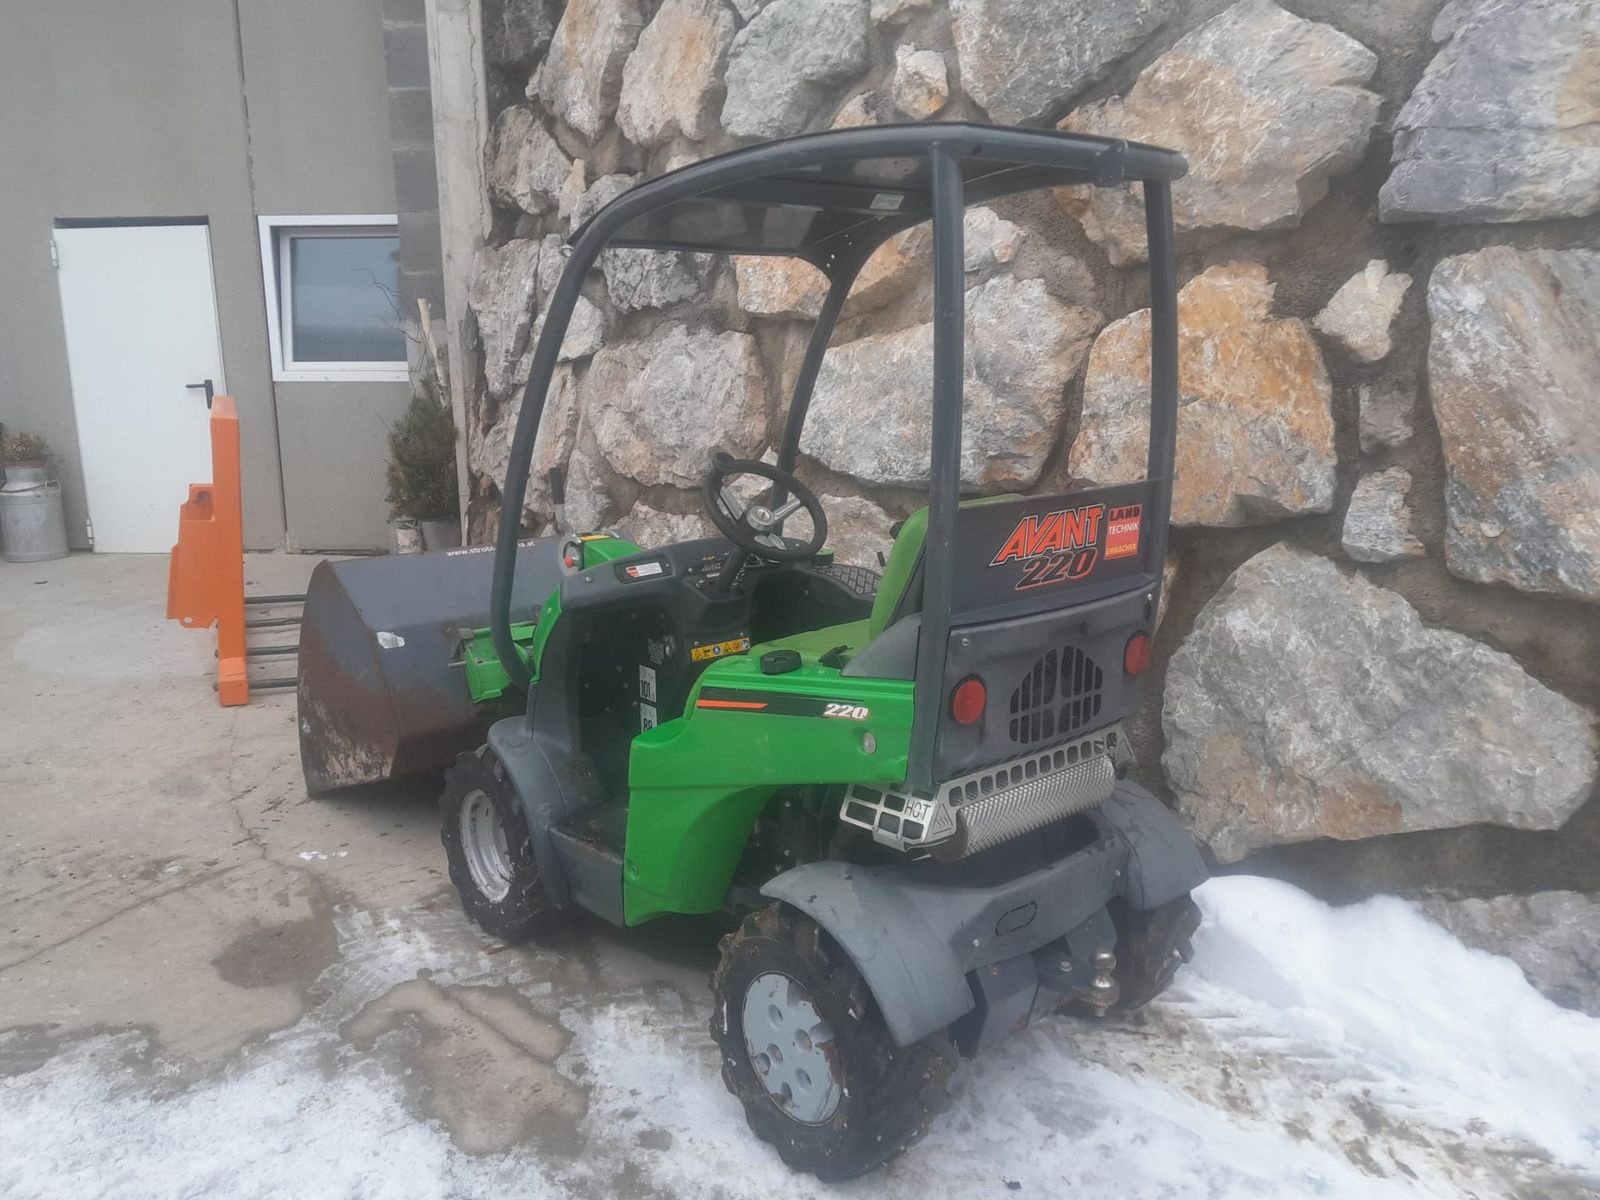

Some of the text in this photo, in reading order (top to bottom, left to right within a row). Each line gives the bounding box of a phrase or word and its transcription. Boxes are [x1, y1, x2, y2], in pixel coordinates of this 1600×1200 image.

[1109, 506, 1140, 522] LAND
[989, 503, 1106, 567] AVANT
[1108, 522, 1140, 536] TECHNIK
[1015, 548, 1098, 591] 220
[822, 703, 870, 721] 220
[904, 801, 931, 819] HOT
